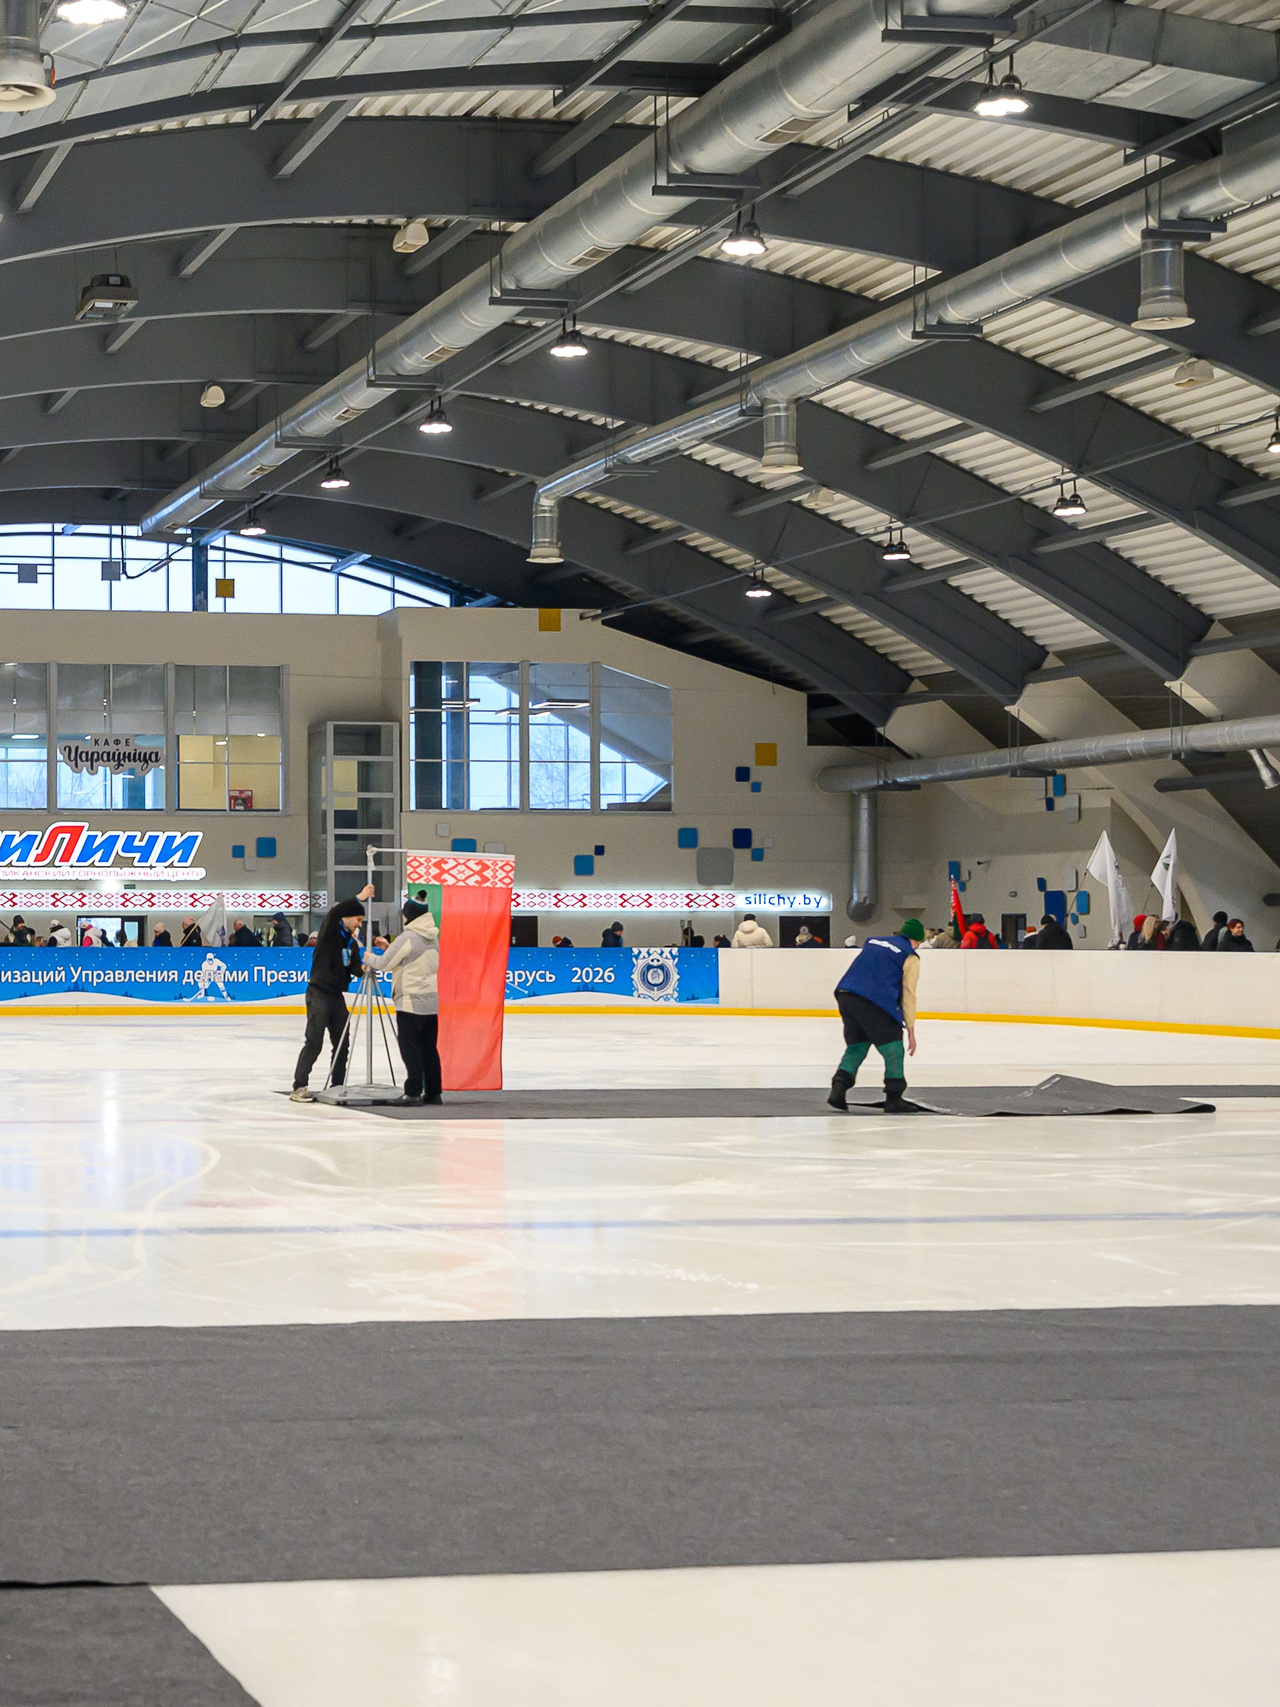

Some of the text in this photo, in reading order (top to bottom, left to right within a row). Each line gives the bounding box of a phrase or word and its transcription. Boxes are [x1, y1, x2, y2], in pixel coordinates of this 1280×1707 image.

[94, 738, 131, 747] КАФЕ
[63, 744, 162, 772] Чараўніца
[167, 869, 204, 879] ЦЕНТР
[745, 893, 822, 908] silichy.by
[71, 966, 178, 988] Управления
[182, 969, 251, 987] делами
[571, 966, 616, 984] 2026
